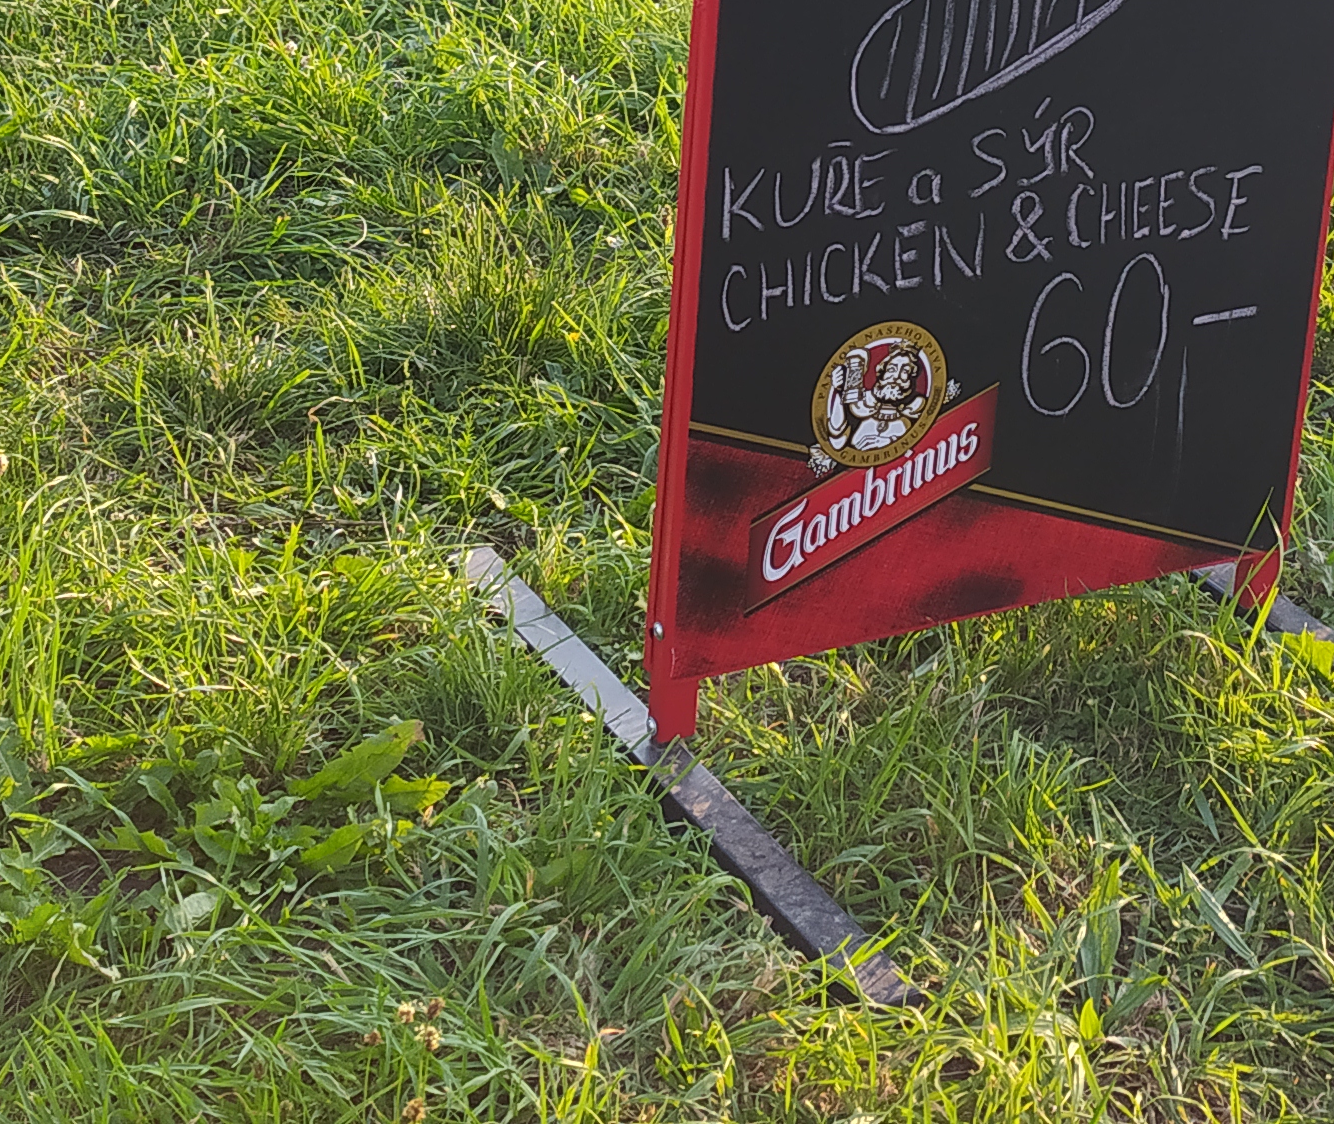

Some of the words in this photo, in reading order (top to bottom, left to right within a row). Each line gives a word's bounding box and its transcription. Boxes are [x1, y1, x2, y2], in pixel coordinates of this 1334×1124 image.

[908, 168, 943, 205] a
[969, 96, 1096, 198] SÝR
[720, 212, 986, 332] CHICKEN
[1005, 188, 1054, 263] &
[1067, 164, 1264, 250] CHEESE
[924, 341, 942, 374] PIVA
[839, 421, 927, 465] GAMBRINUS
[762, 422, 979, 582] Gambrinus
